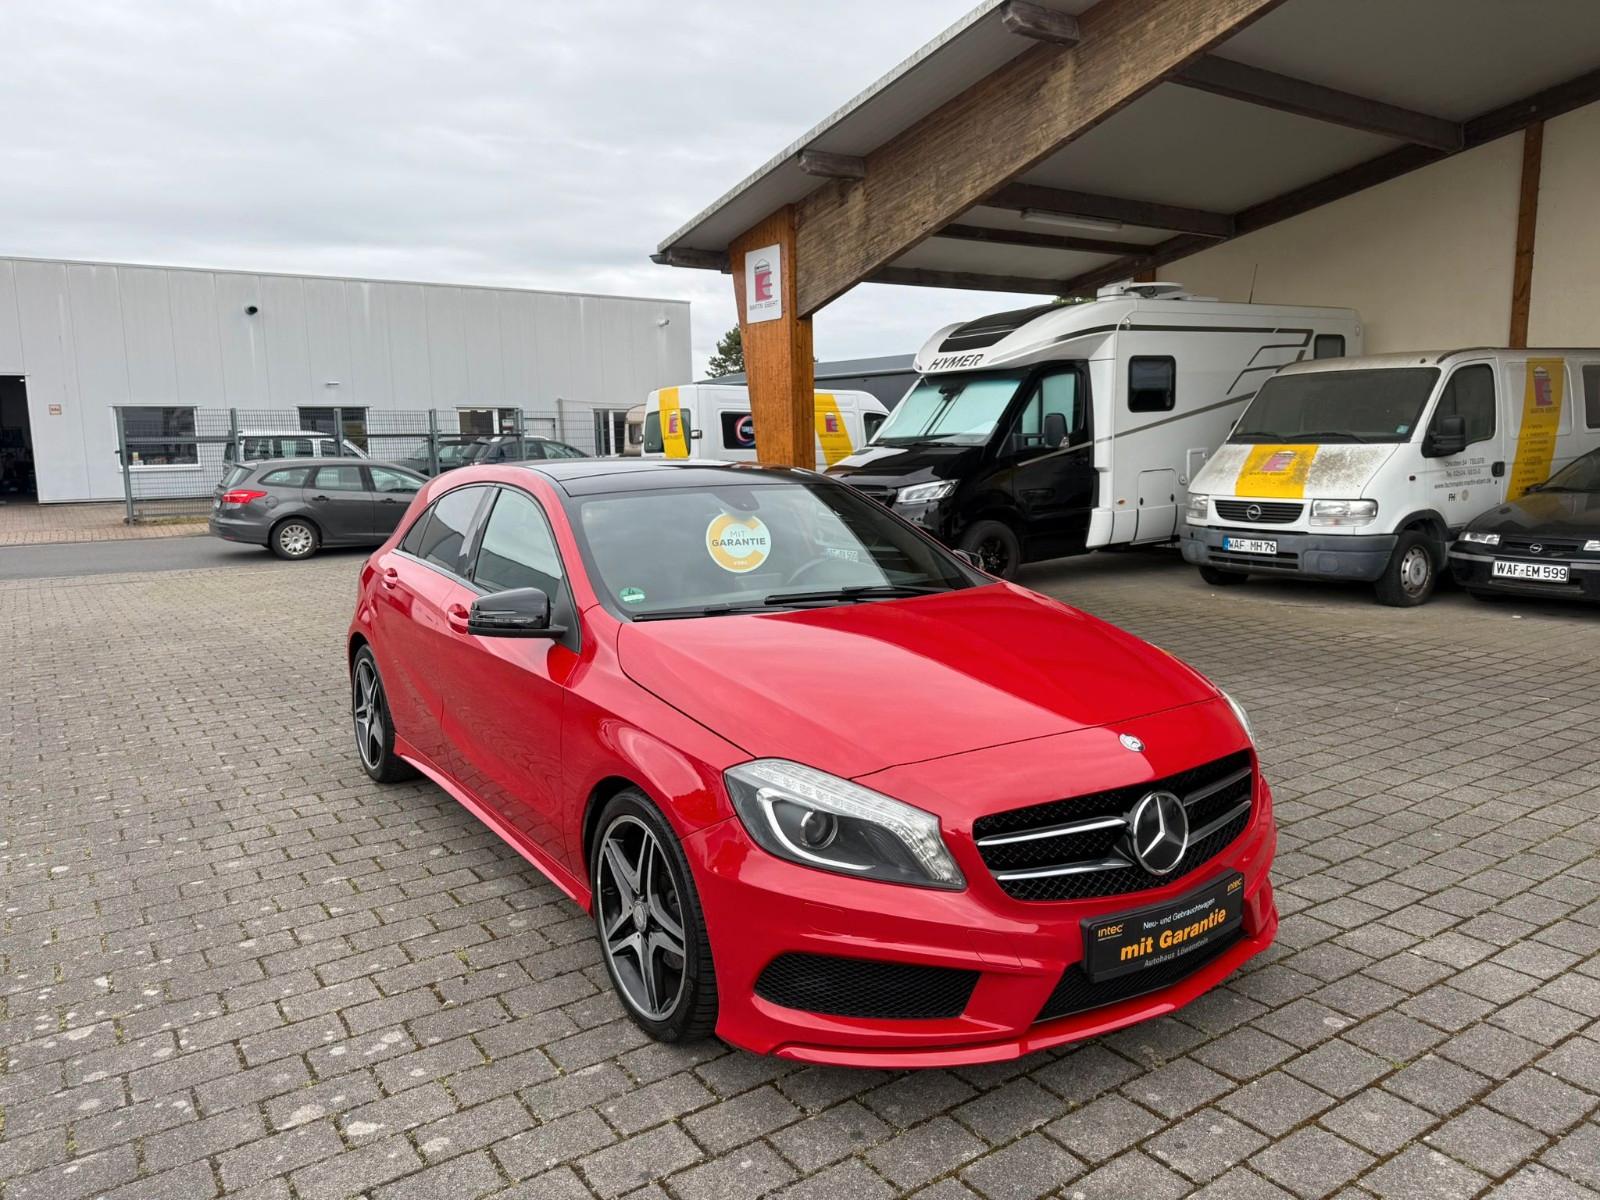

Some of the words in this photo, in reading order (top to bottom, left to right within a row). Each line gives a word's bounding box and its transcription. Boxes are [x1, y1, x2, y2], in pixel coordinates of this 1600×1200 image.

[928, 354, 984, 370] HYMER
[711, 537, 766, 547] GARANTIE
[1228, 539, 1245, 550] WAF
[1543, 566, 1567, 579] 599
[1143, 920, 1158, 930] Neu-
[1160, 915, 1171, 925] und
[1120, 936, 1153, 961] mit
[1159, 908, 1226, 949] Garantie
[1144, 951, 1175, 968] Autohaus
